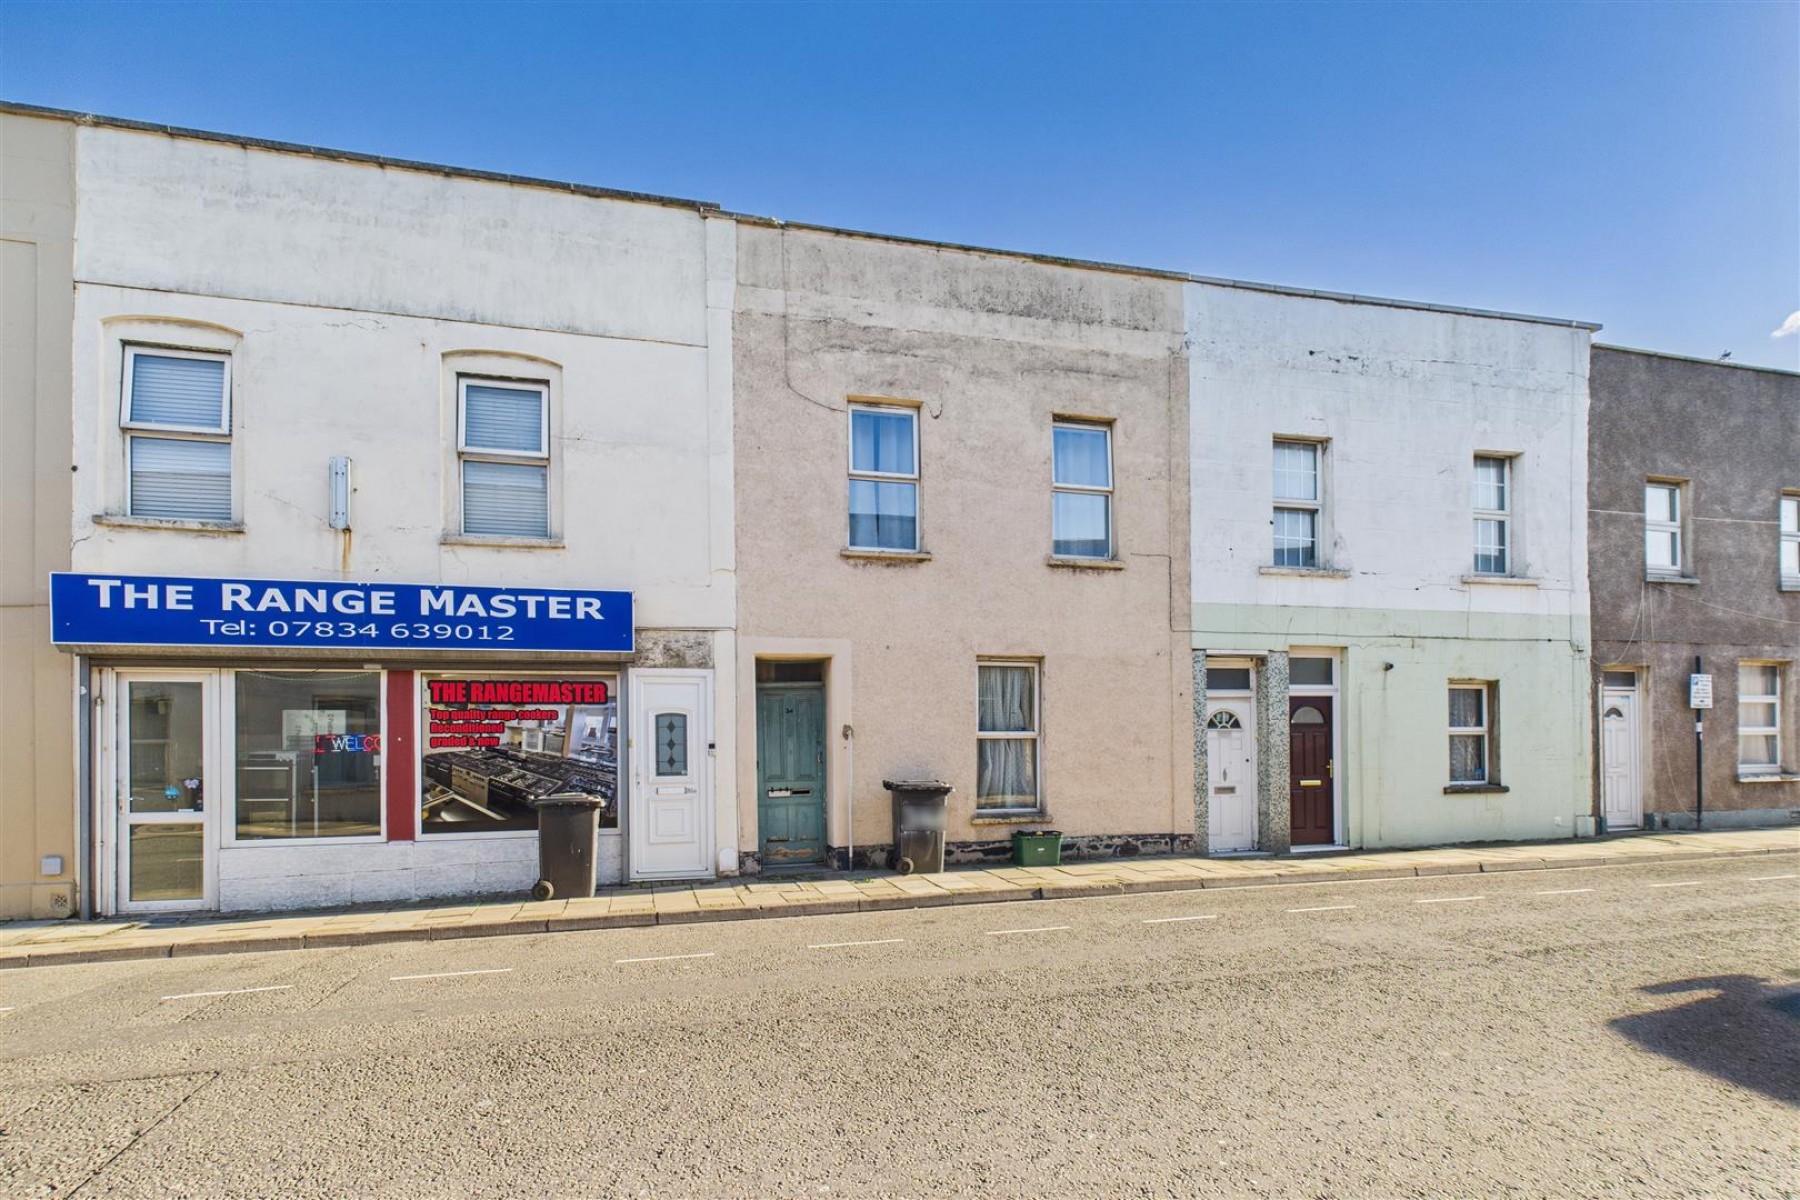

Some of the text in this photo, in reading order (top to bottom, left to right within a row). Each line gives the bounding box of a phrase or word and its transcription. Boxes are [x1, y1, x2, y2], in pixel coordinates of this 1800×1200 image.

[87, 578, 605, 620] THE RANGE MASTER
[199, 619, 515, 641] Tel: 07834 639012
[429, 681, 606, 703] THE RANGEMASTER
[430, 709, 558, 721] Top quality range cookers
[430, 722, 505, 733] Reconditioned
[430, 736, 499, 748] graded & new
